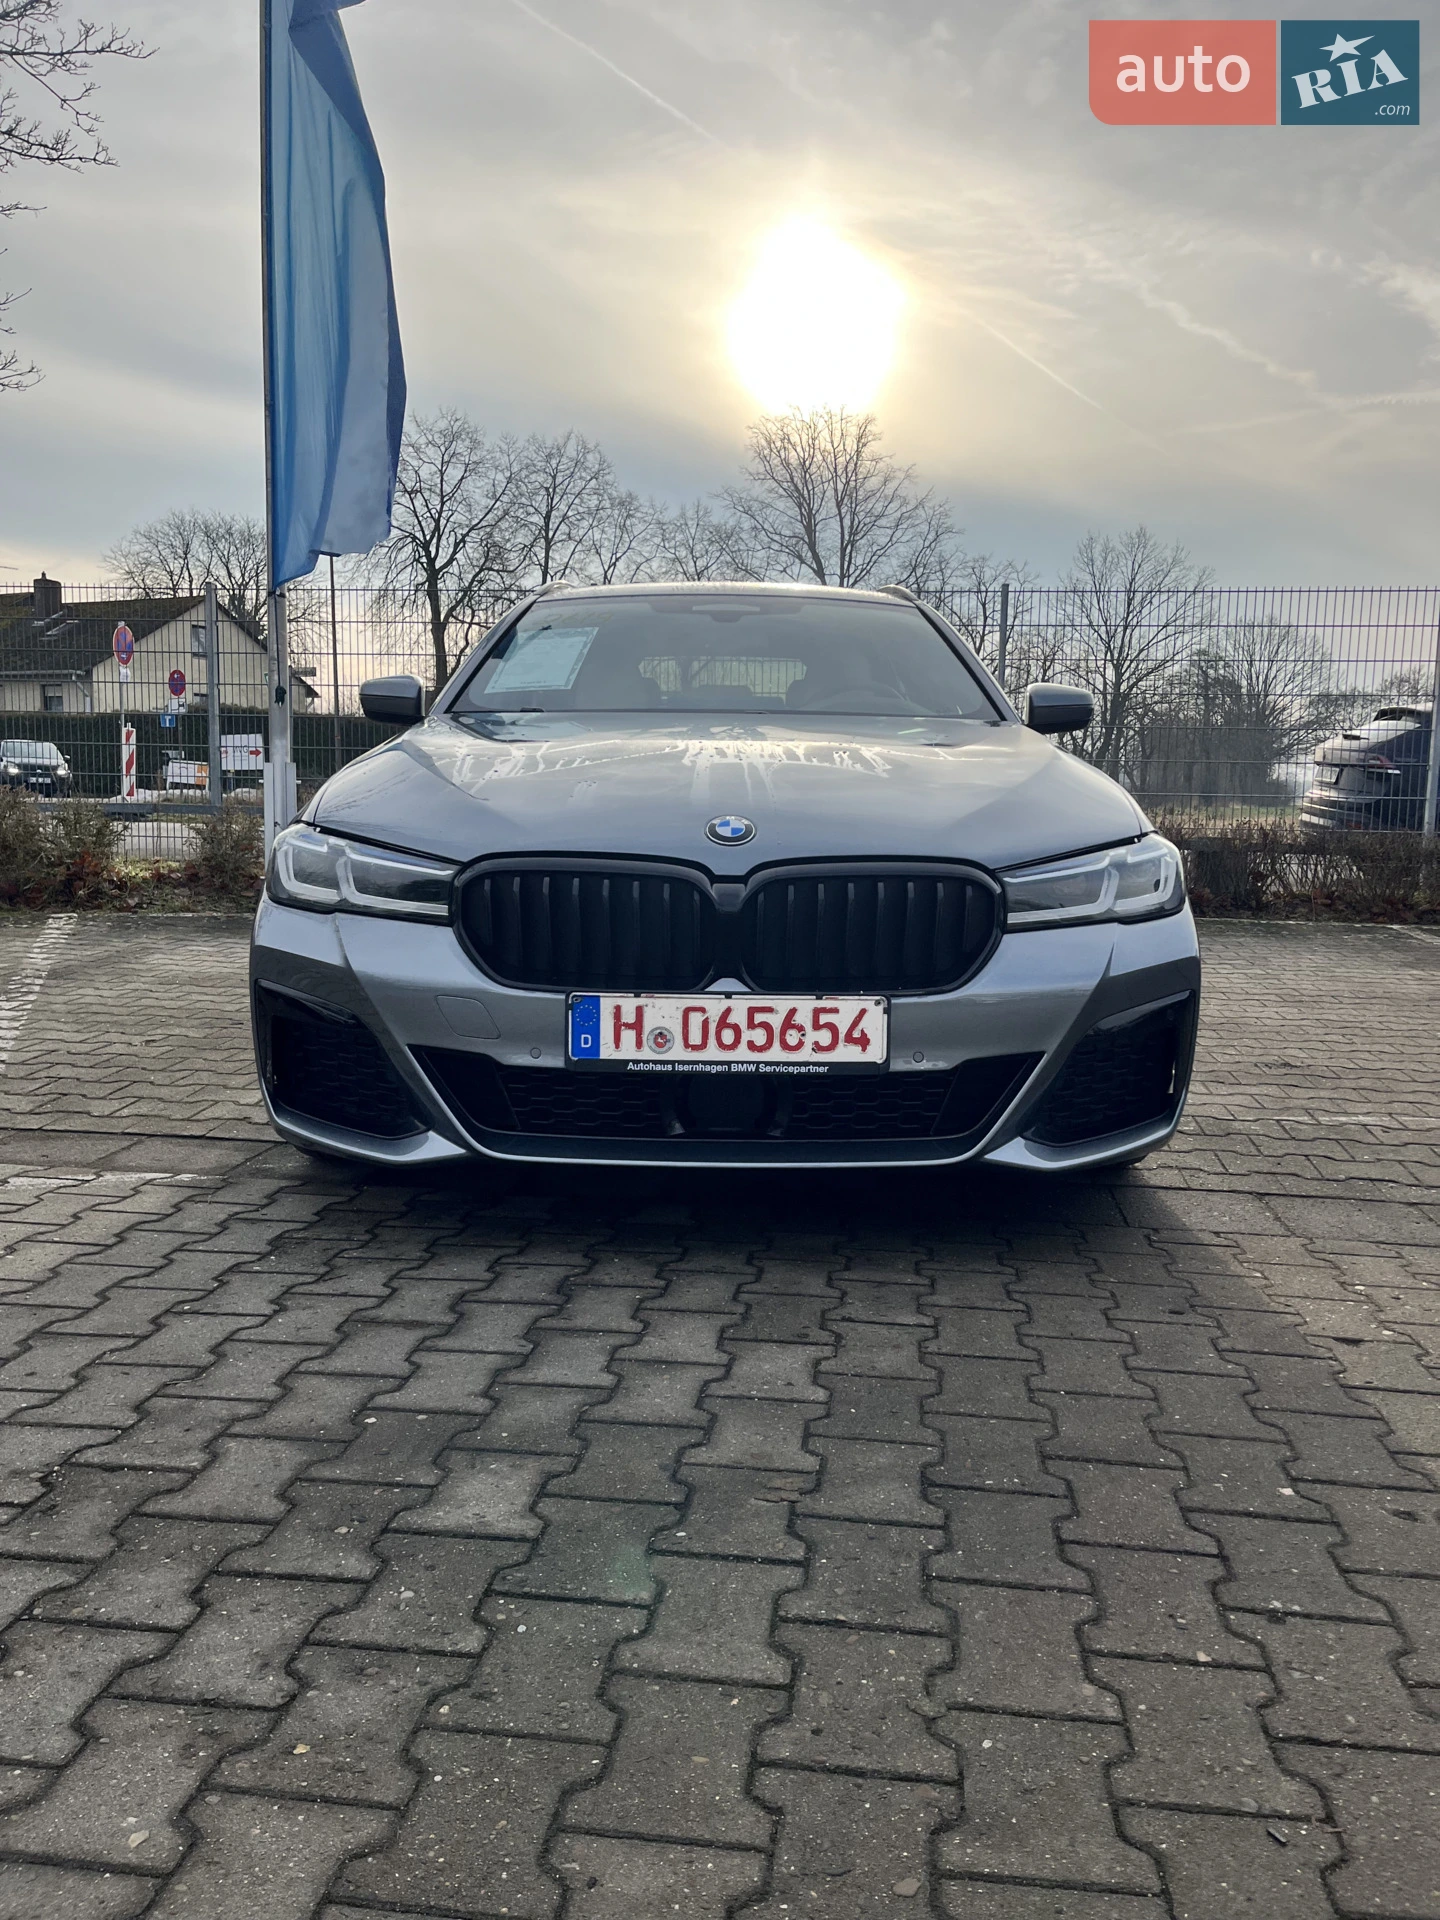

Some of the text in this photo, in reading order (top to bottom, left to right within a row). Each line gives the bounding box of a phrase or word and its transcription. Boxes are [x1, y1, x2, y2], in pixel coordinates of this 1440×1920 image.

[612, 1004, 645, 1051] H
[681, 1005, 871, 1053] 065654
[580, 1034, 592, 1048] D
[627, 1061, 829, 1075] Autohaus Isernhagen BMW Servicepartner
